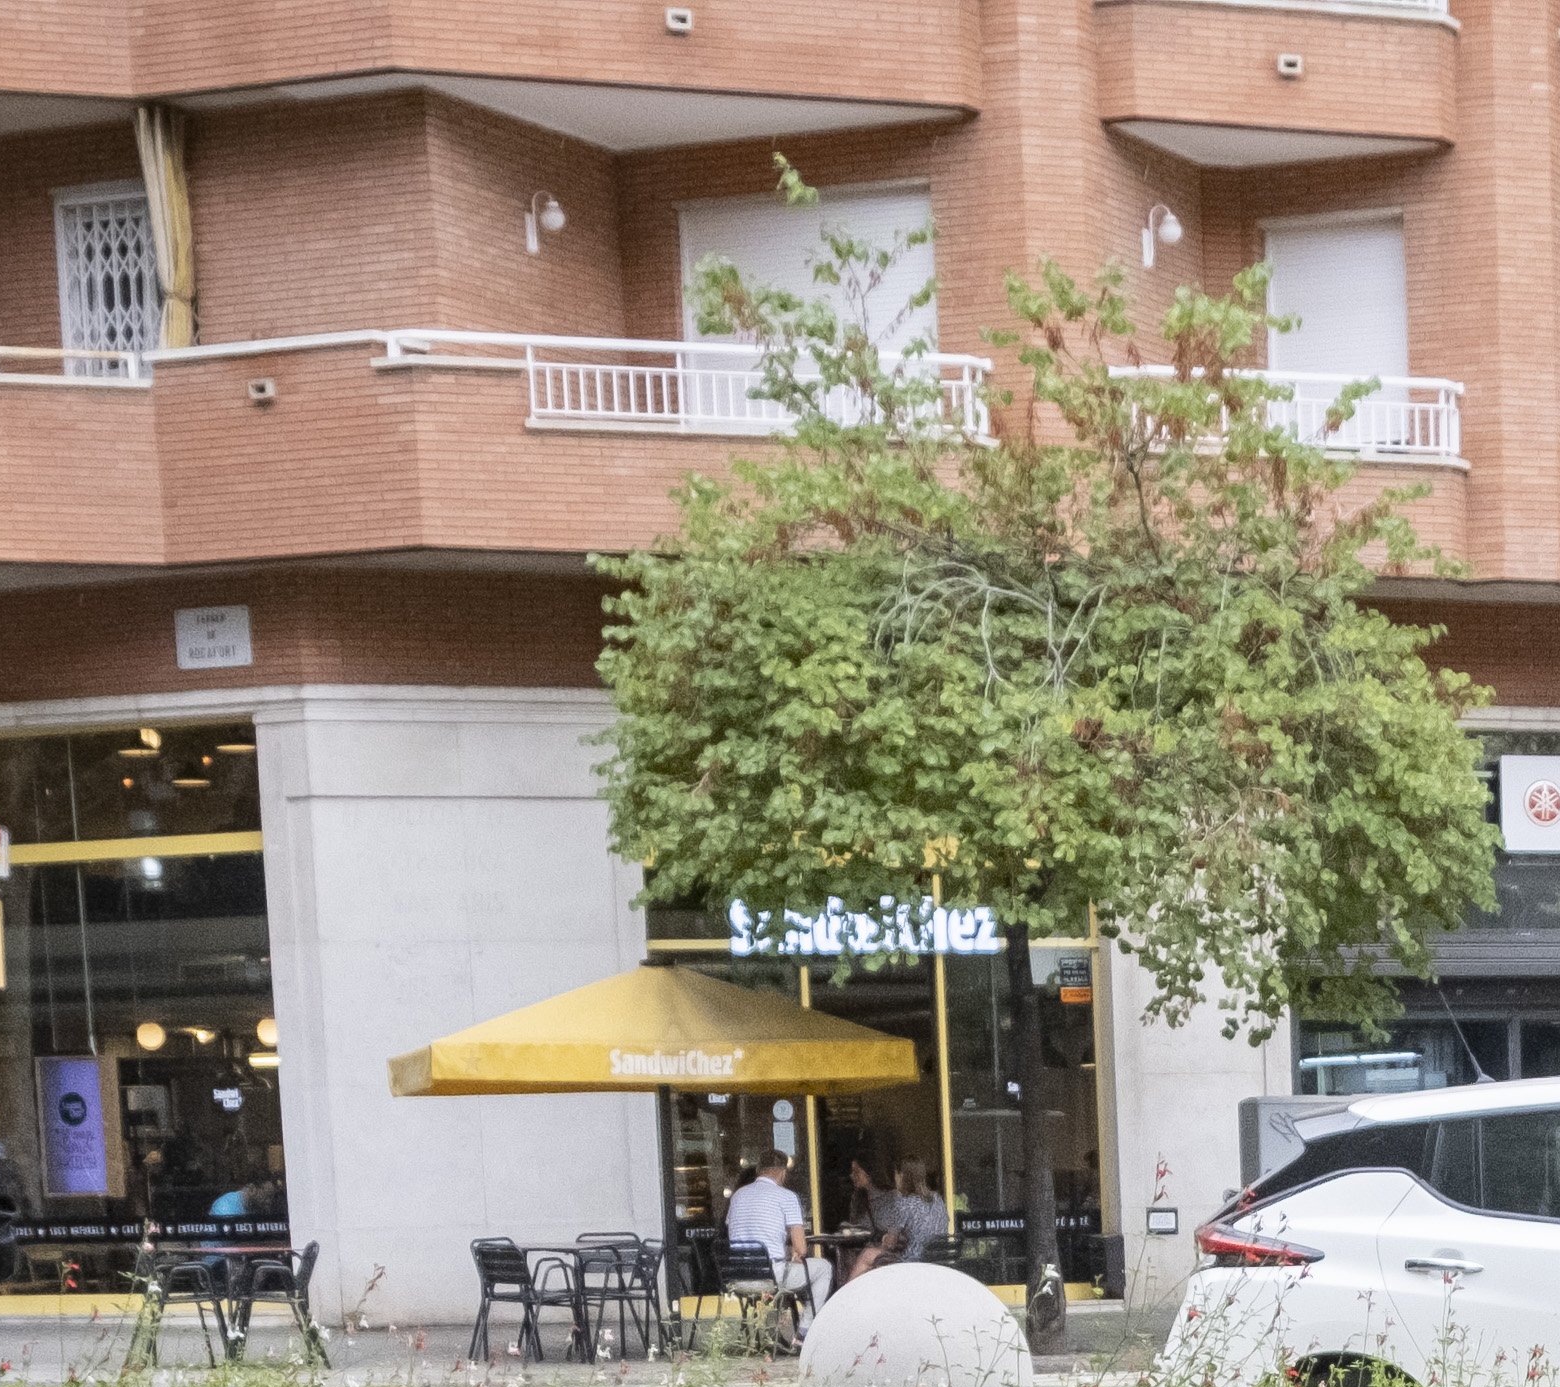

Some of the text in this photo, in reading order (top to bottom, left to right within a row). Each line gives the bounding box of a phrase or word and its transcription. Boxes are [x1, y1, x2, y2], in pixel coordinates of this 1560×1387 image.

[609, 1048, 734, 1076] SandwiChez
[256, 1221, 288, 1232] NATURAL
[962, 1218, 1024, 1230] SUCS NATURALS
